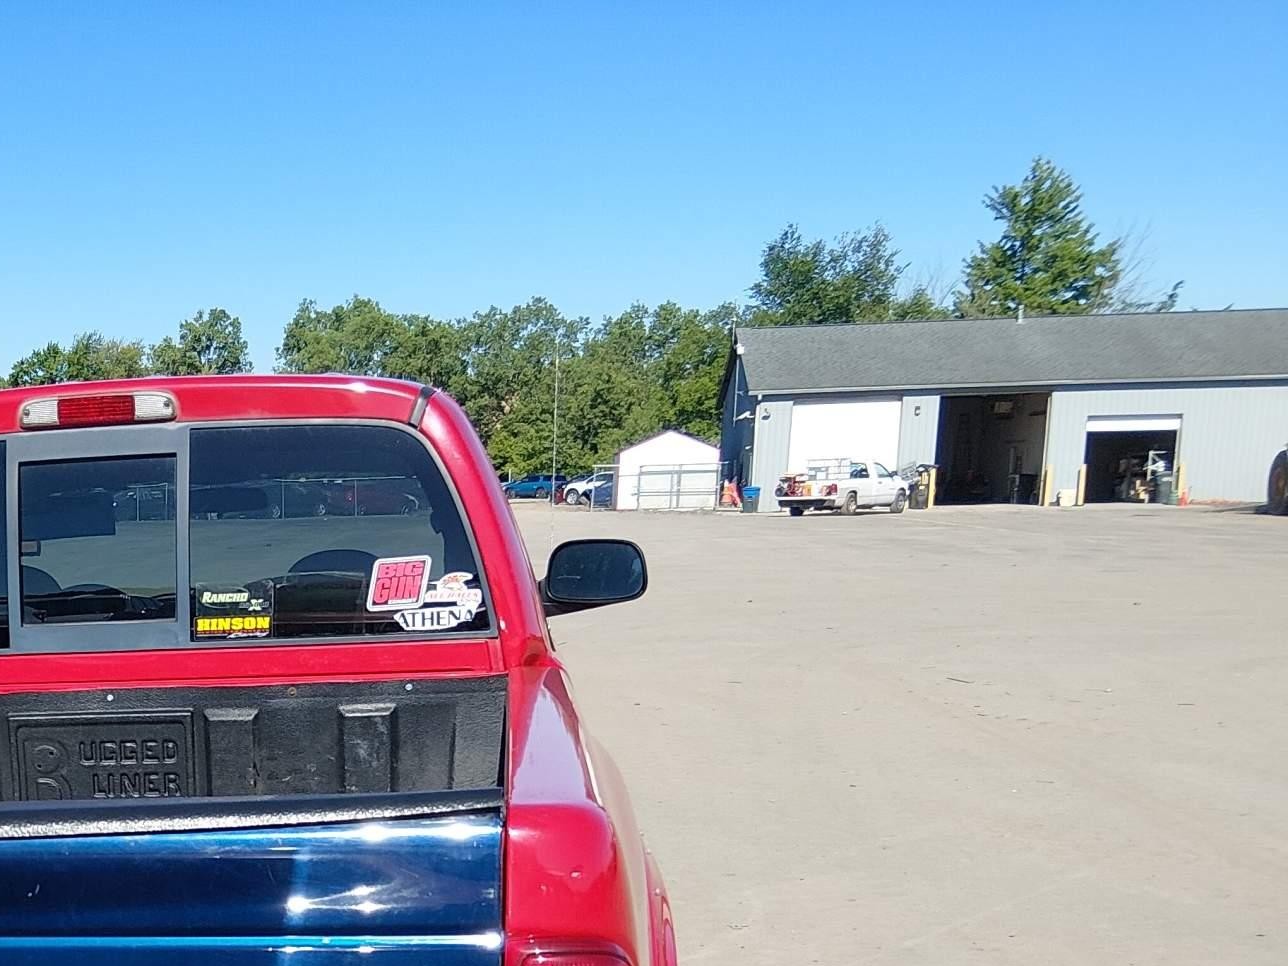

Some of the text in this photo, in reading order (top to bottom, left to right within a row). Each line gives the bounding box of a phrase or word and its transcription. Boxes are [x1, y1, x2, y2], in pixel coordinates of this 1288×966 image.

[377, 561, 424, 578] BIG
[201, 592, 249, 604] RANCHO
[373, 575, 421, 604] GUN
[197, 617, 270, 632] HINSON
[398, 609, 473, 628] ATHENA
[92, 772, 181, 798] LINER
